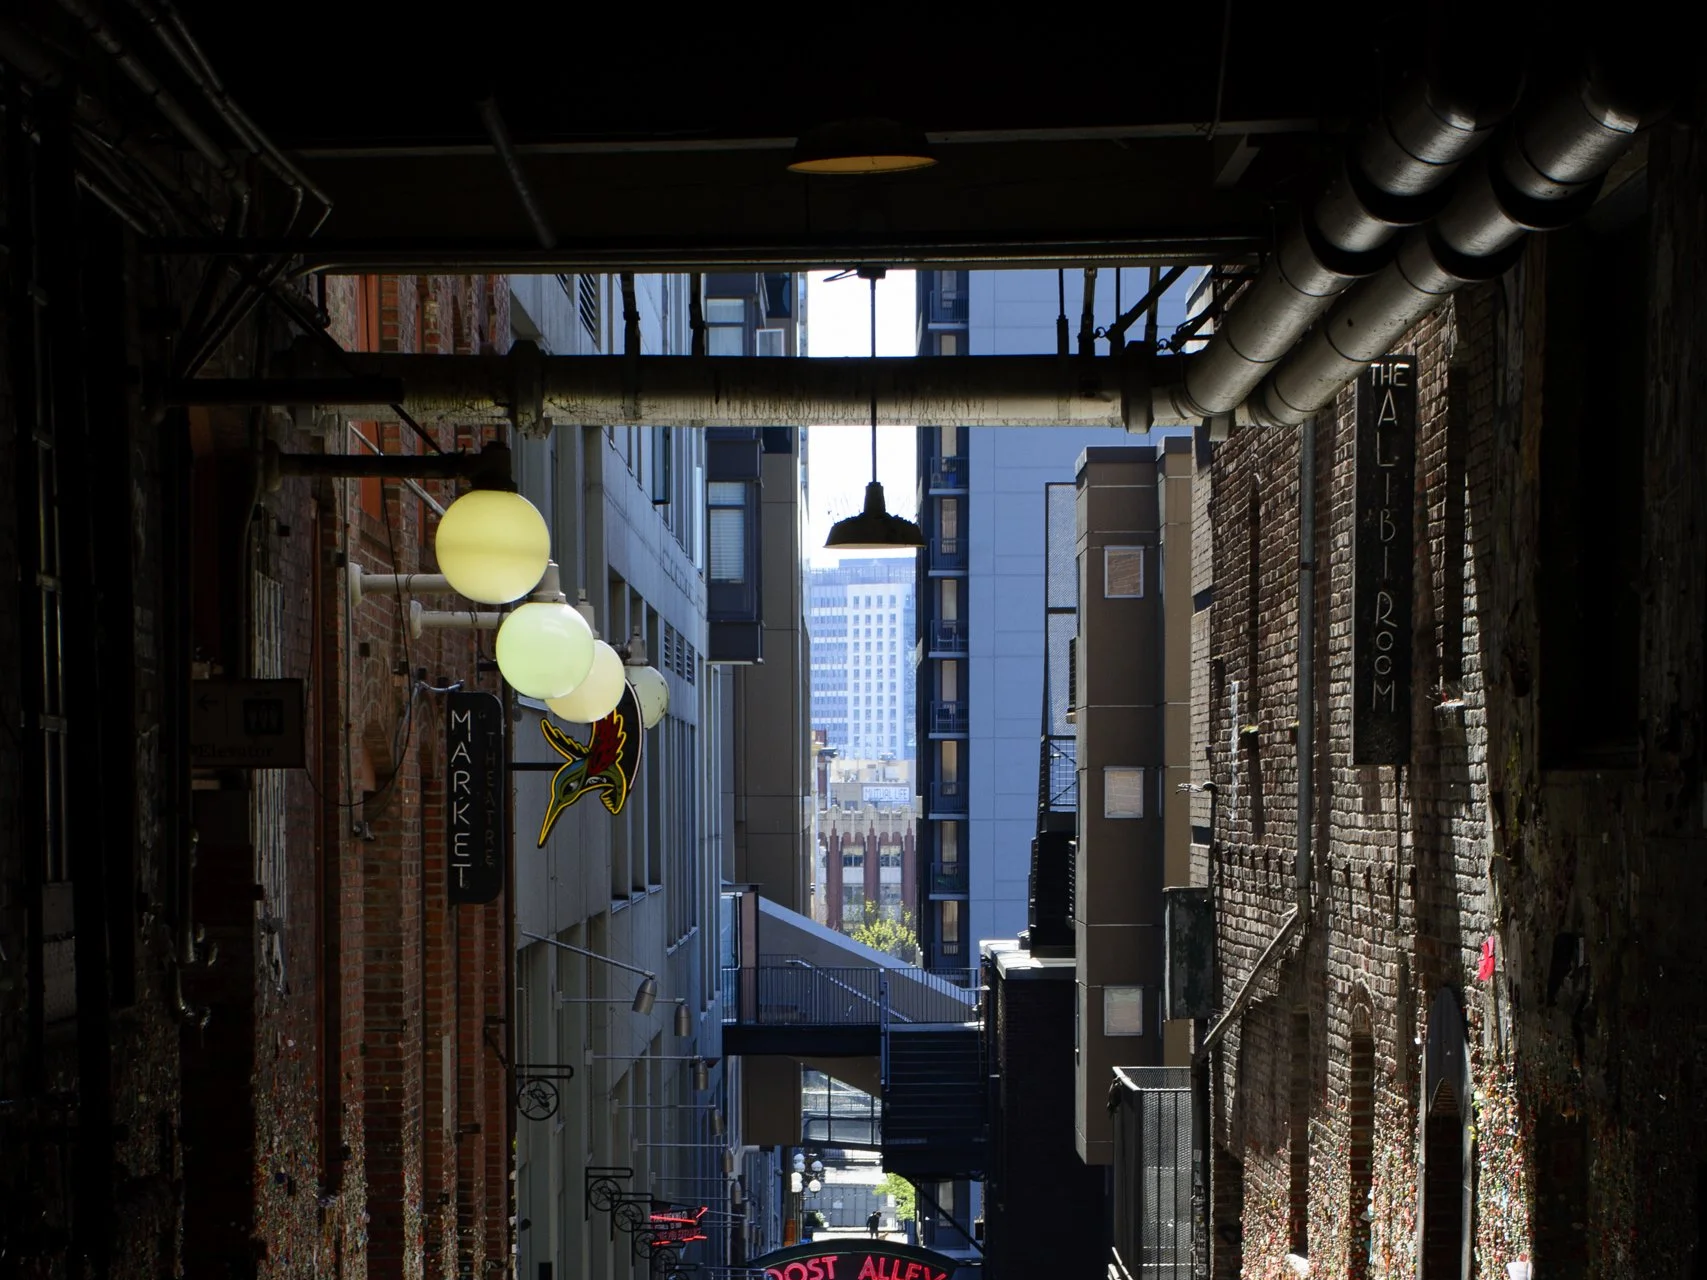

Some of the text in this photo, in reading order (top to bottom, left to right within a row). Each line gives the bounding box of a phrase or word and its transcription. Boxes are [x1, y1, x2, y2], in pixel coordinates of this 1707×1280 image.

[1370, 362, 1410, 387] THE
[1372, 388, 1398, 713] ALIBI ROOM
[451, 708, 472, 889] MARKET
[484, 731, 496, 868] THEATRE
